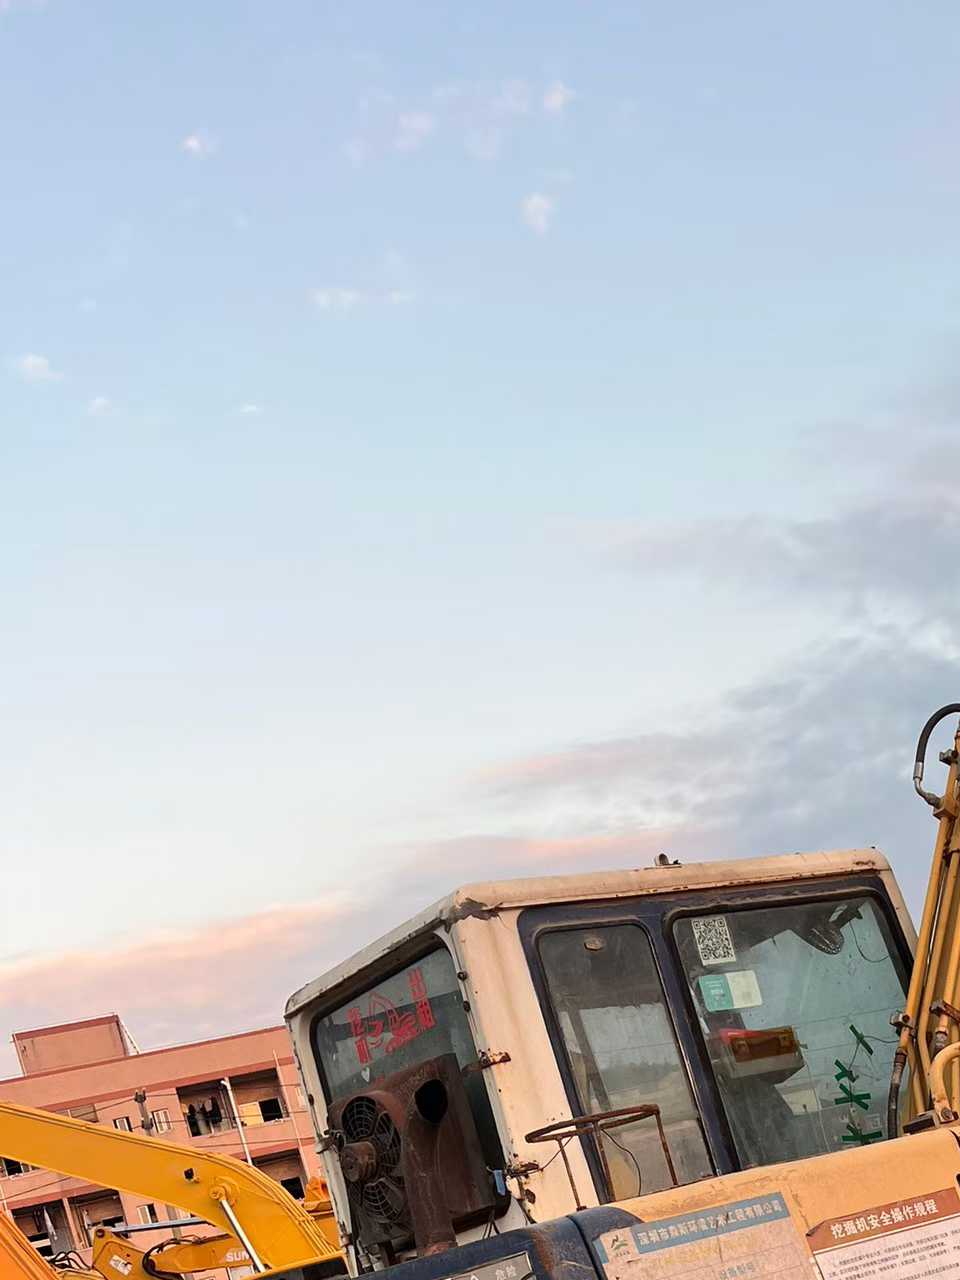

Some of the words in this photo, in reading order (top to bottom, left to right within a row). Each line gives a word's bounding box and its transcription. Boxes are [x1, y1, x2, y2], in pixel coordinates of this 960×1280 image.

[830, 1199, 940, 1240] 挖掘机安全操作规程
